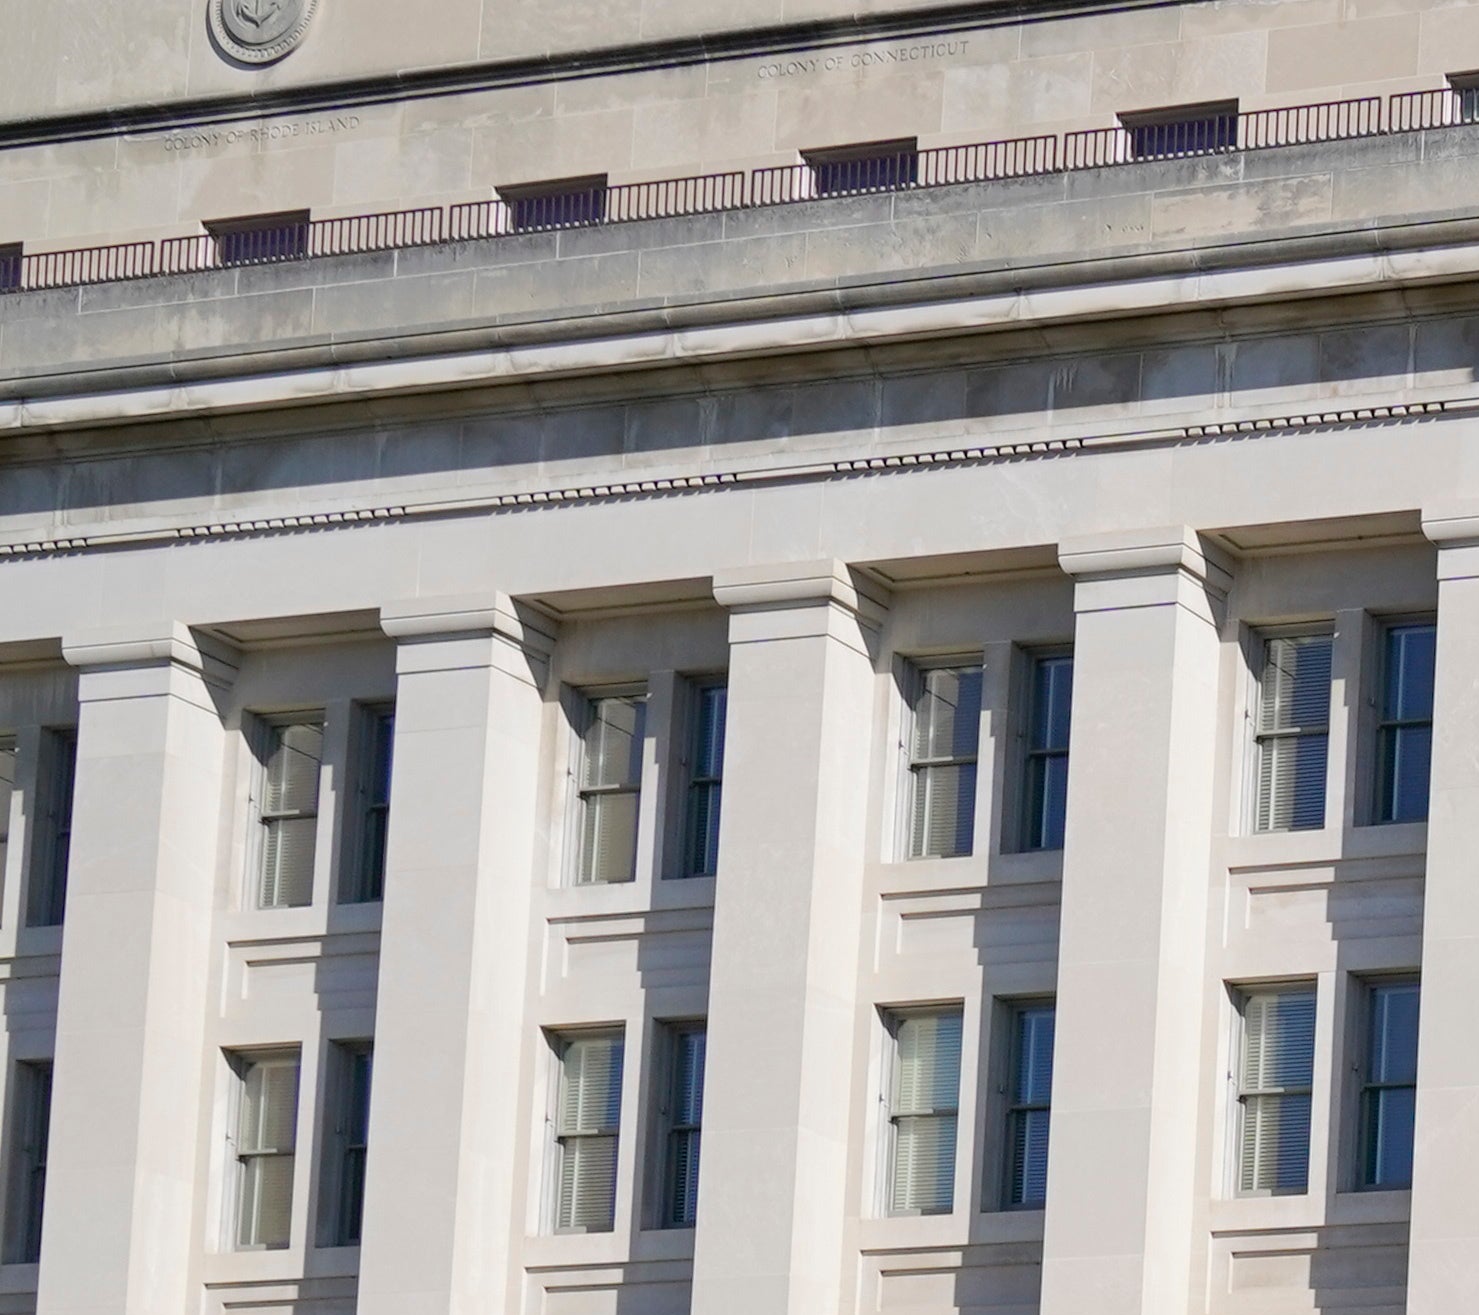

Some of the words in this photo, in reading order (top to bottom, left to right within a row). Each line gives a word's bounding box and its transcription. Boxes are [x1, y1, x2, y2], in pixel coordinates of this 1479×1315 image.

[757, 59, 819, 79] COLONY
[824, 56, 843, 71] OF
[850, 41, 969, 69] CONNECTICUT
[163, 132, 222, 152] COLONY
[226, 130, 244, 144] OF
[249, 123, 299, 142] RHODE
[305, 116, 360, 135] ISLAND
